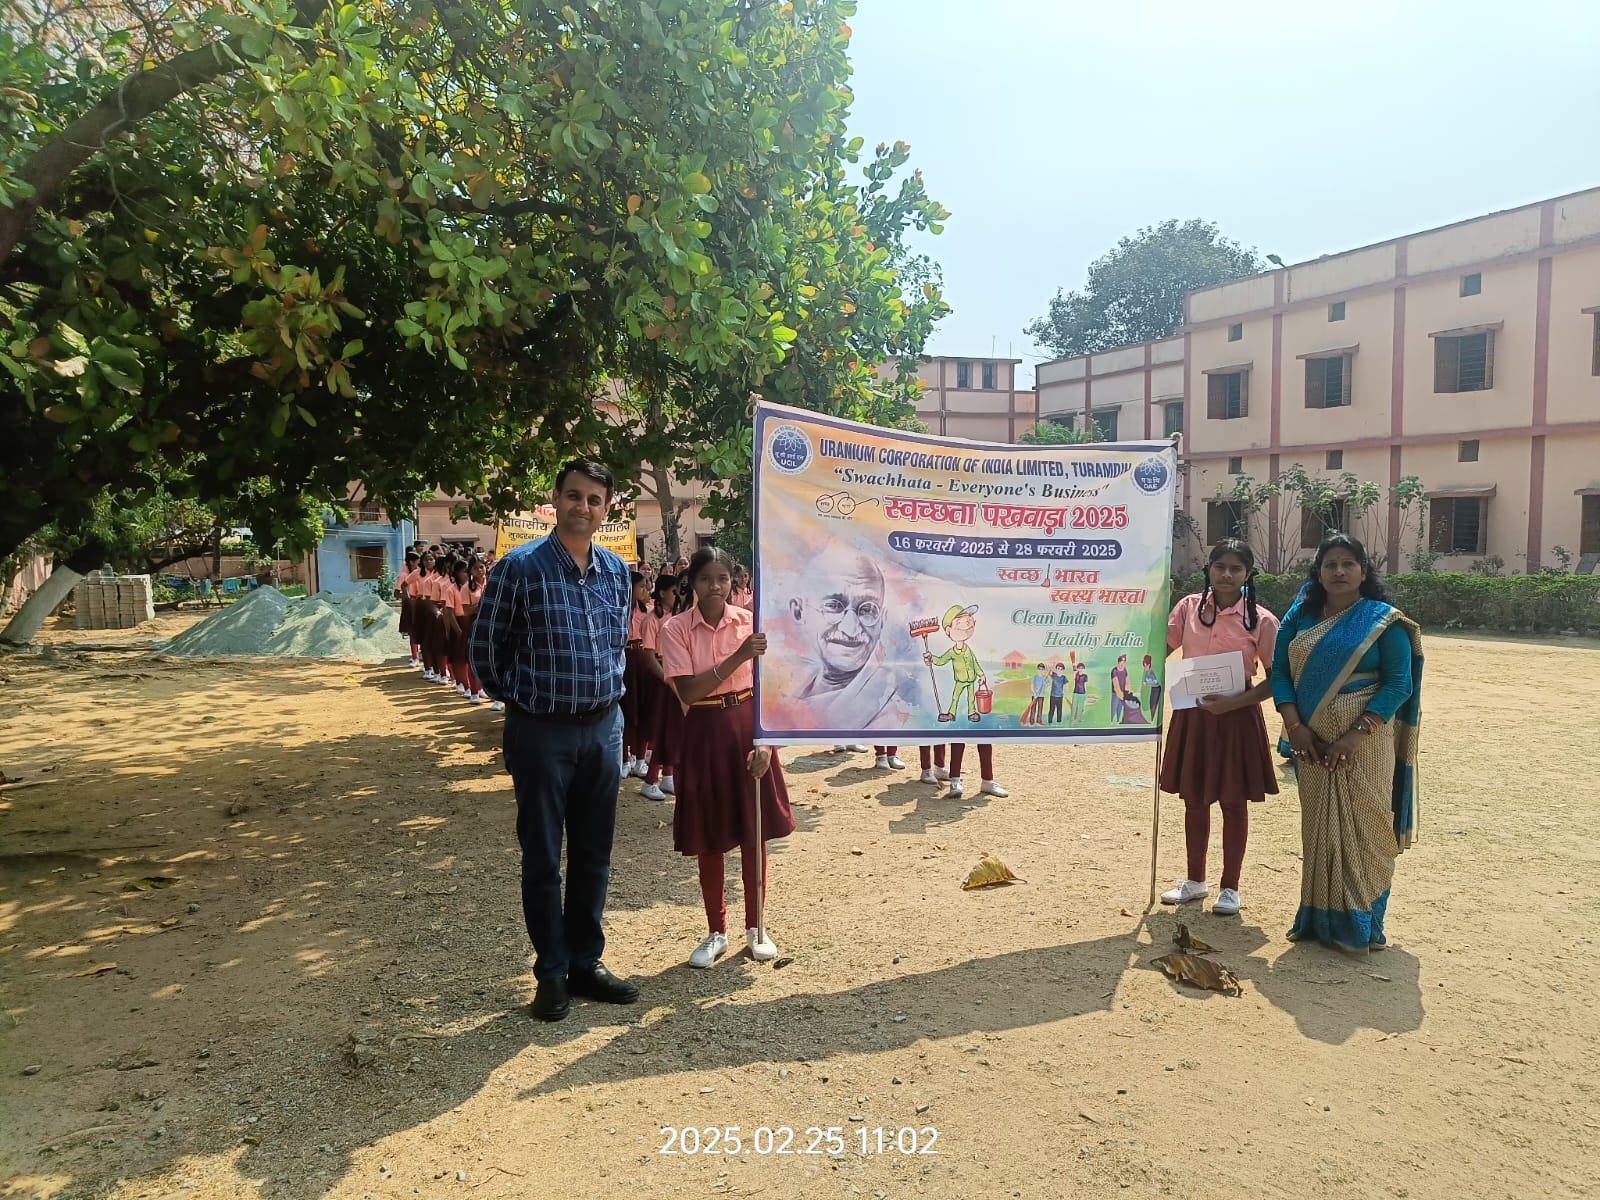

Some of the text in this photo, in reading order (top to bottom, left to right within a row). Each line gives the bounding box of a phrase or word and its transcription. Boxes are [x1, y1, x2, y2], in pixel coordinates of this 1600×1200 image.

[820, 438, 875, 463] URANIUM
[879, 447, 961, 472] CORPORATION
[964, 458, 979, 473] OF
[982, 459, 1013, 475] INDIA
[1016, 459, 1069, 479] LIMITED,
[948, 478, 1036, 501] Everyone's
[885, 497, 1128, 536] स्वच्छता पखवाड़ा 2025
[894, 537, 1117, 557] 16 फरवरी 2025 से 28 फरवरी 2025
[998, 567, 1101, 584] स्वच्छ भारत
[1050, 589, 1096, 603] स्वस्थ
[1012, 610, 1097, 625] Clean India
[1045, 632, 1145, 649] Healthy India.
